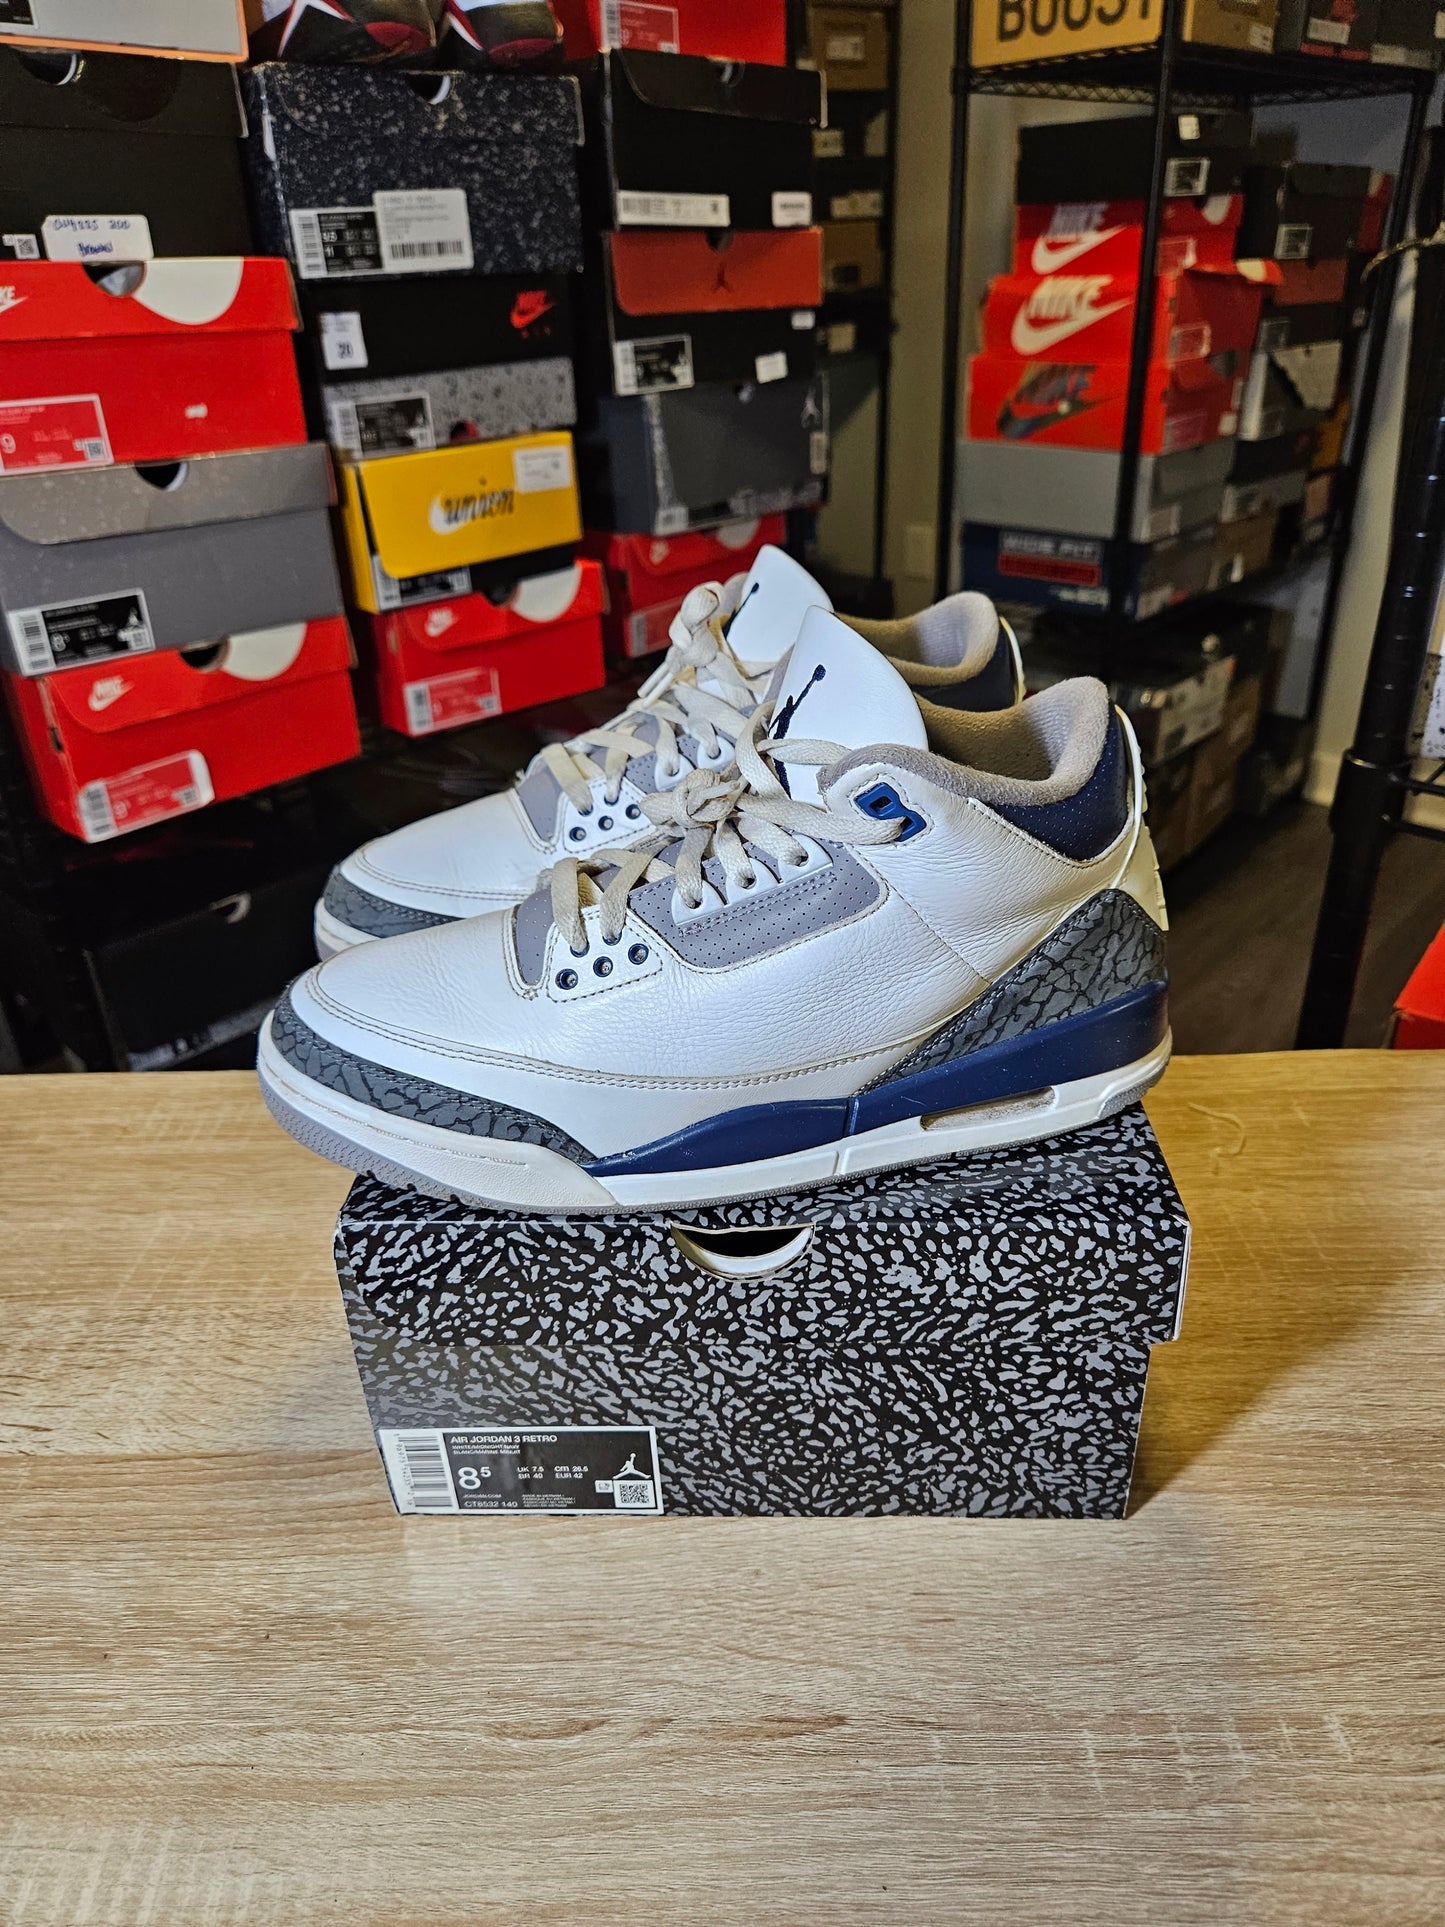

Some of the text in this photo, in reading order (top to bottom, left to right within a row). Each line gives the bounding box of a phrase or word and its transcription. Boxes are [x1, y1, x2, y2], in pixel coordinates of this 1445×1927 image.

[470, 1435, 512, 1443] JORDAN
[513, 1435, 520, 1443] 3
[522, 1435, 558, 1443] RETRO
[531, 1465, 544, 1473] 7.5
[501, 1500, 518, 1508] 140
